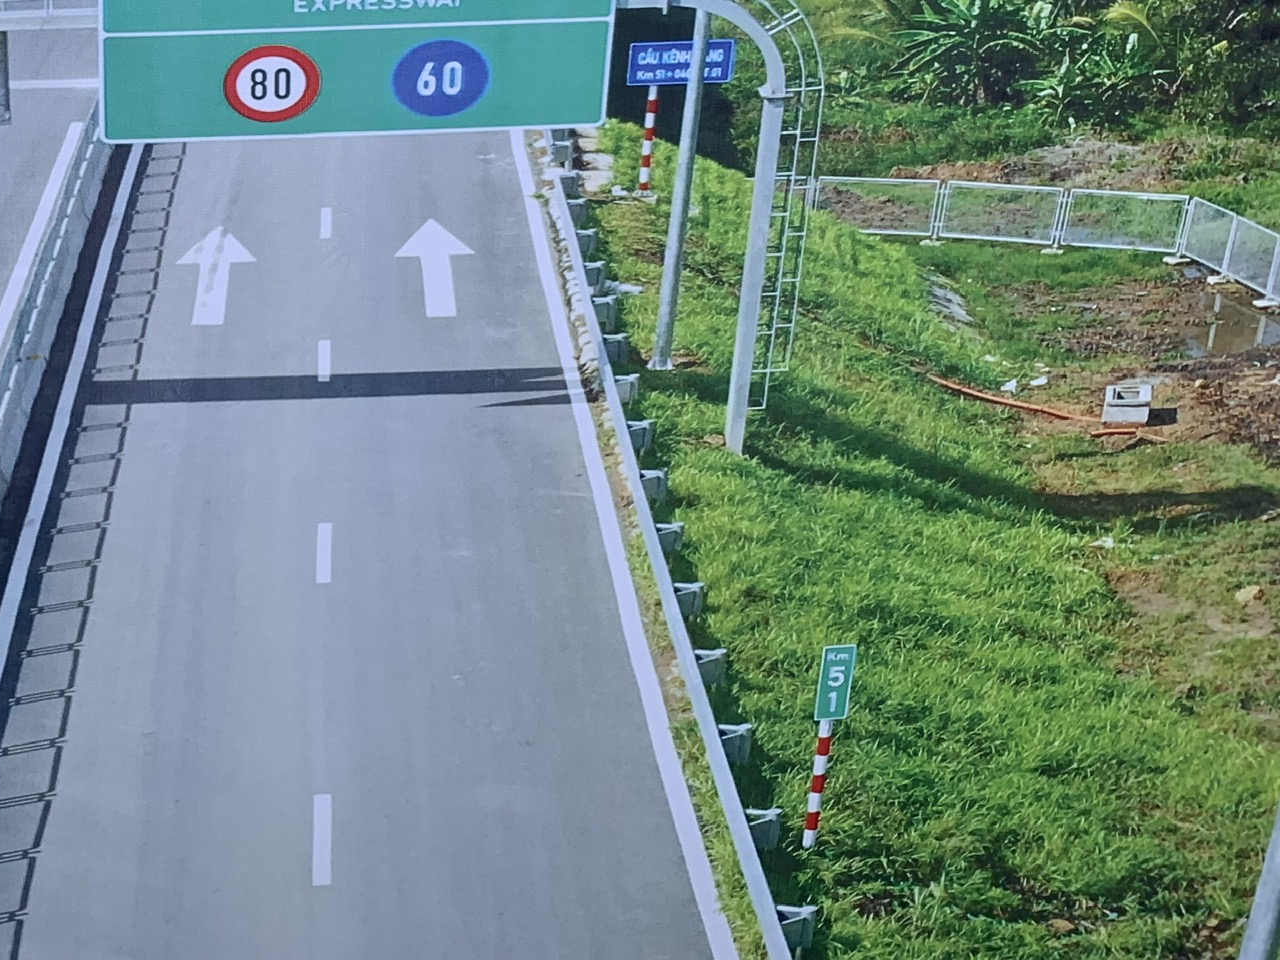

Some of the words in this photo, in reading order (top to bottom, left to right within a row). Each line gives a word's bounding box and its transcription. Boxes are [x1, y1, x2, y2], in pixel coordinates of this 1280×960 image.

[250, 67, 291, 100] 80
[416, 61, 463, 96] 60
[636, 70, 654, 80] Km
[826, 652, 850, 662] Km
